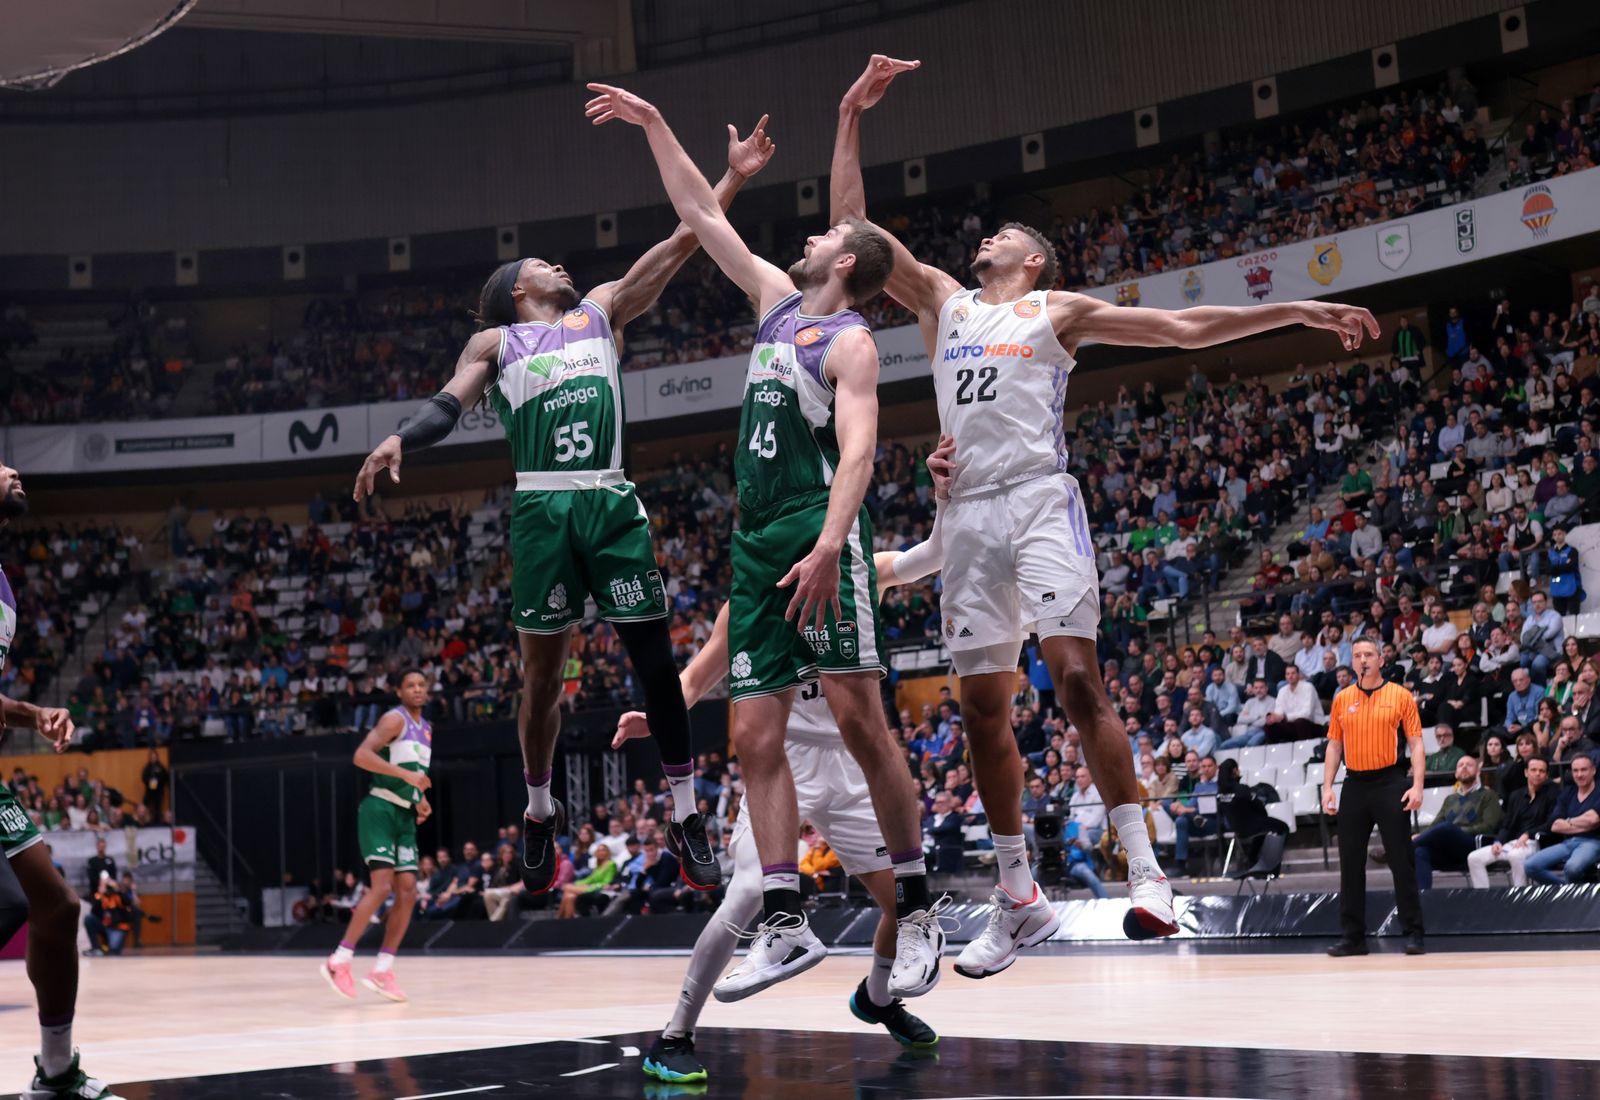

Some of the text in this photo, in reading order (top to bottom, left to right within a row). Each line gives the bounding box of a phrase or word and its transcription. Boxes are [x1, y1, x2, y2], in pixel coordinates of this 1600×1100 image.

[1237, 252, 1278, 268] CAZOO
[944, 343, 1034, 362] AUTOHERO
[659, 376, 712, 397] divina
[956, 366, 998, 405] 22
[543, 385, 598, 412] málaga
[554, 421, 594, 462] 55
[748, 421, 777, 458] 45
[615, 574, 643, 595] má
[612, 590, 646, 607] laga
[137, 842, 176, 863] cb
